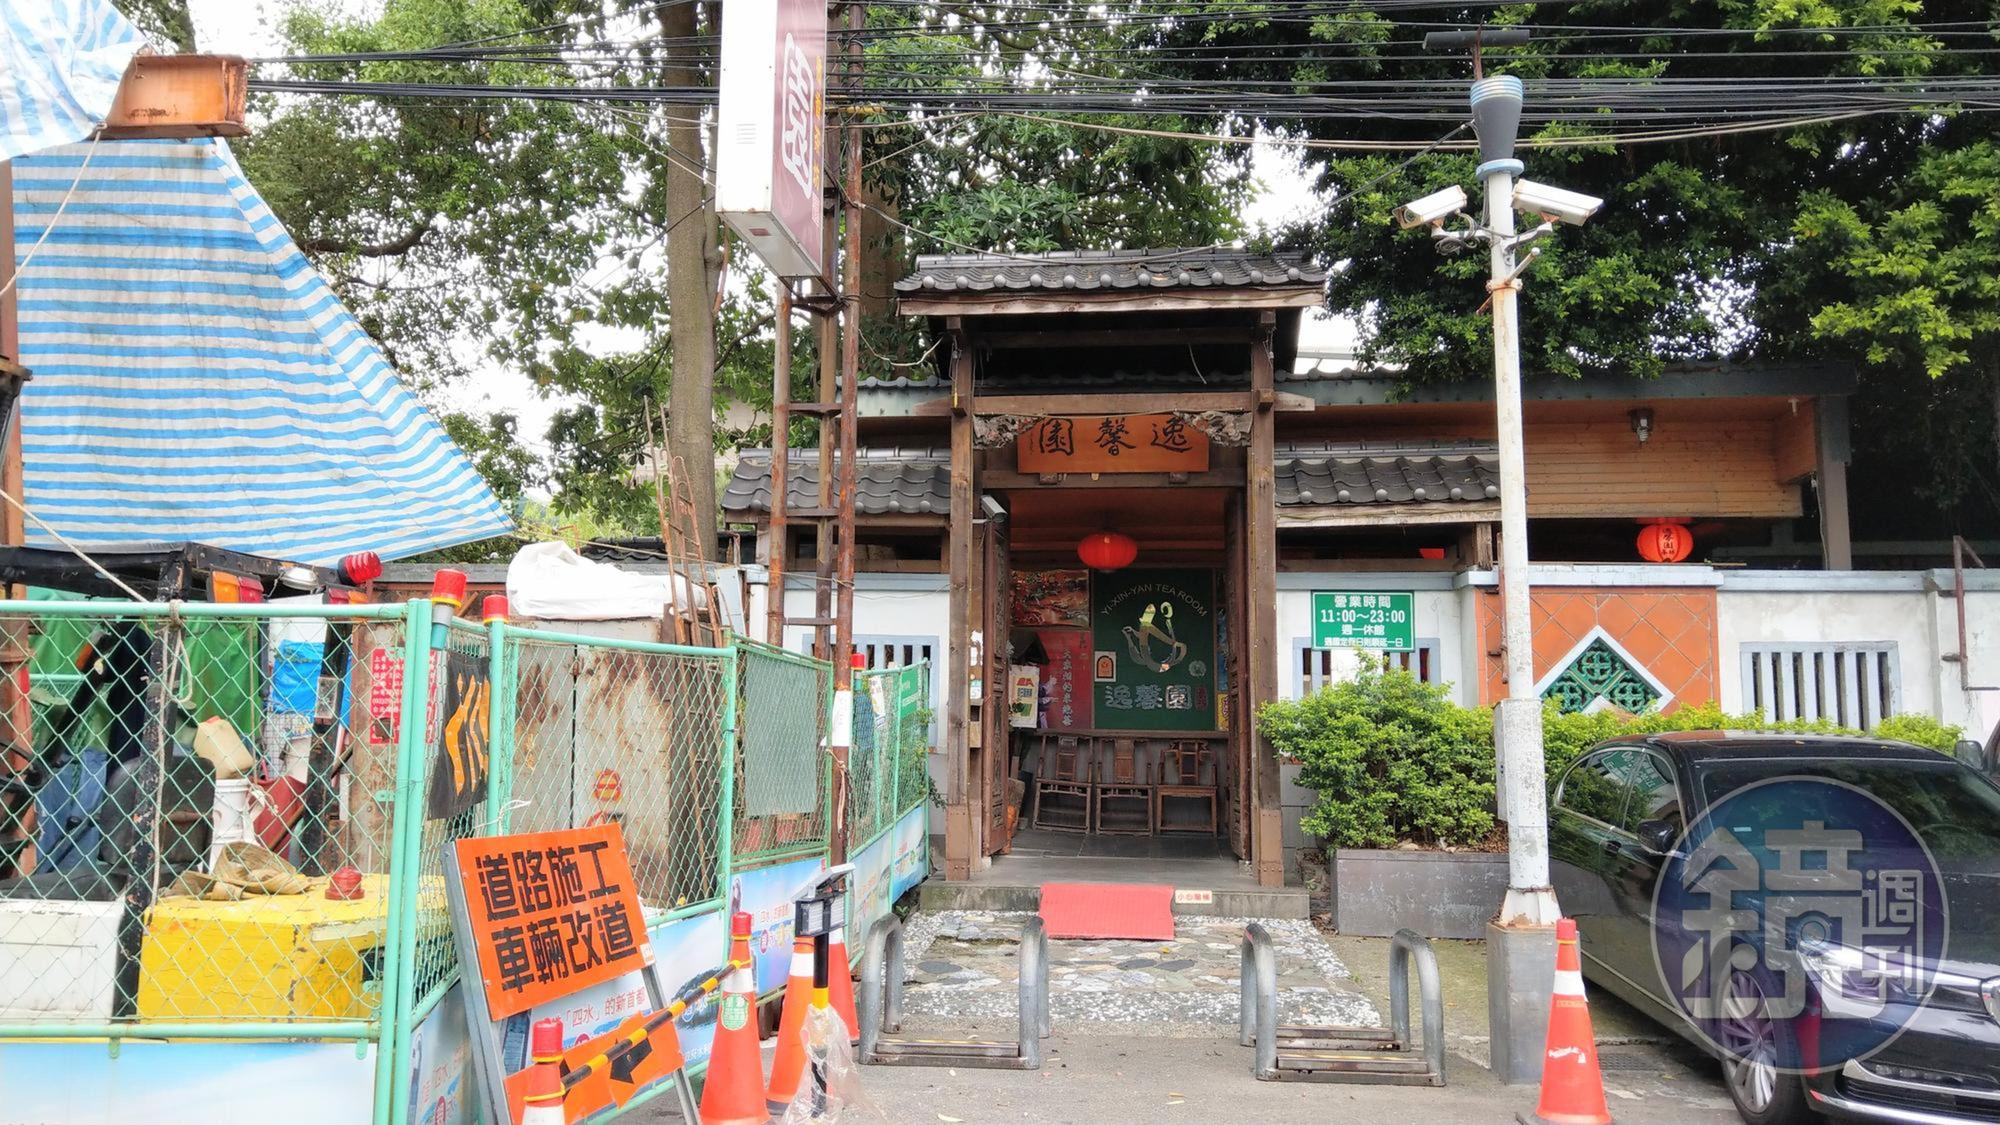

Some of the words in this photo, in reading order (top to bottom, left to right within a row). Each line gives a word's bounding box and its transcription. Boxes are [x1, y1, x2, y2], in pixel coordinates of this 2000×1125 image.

[1101, 583, 1152, 617] YI-XIN-YAN
[1155, 583, 1176, 597] TEA
[1177, 591, 1208, 618] ROOM
[1334, 595, 1392, 609] 營業時間
[1341, 623, 1386, 636] 週一休館
[475, 841, 621, 922] 道路施工
[490, 900, 638, 994] 車輛改道
